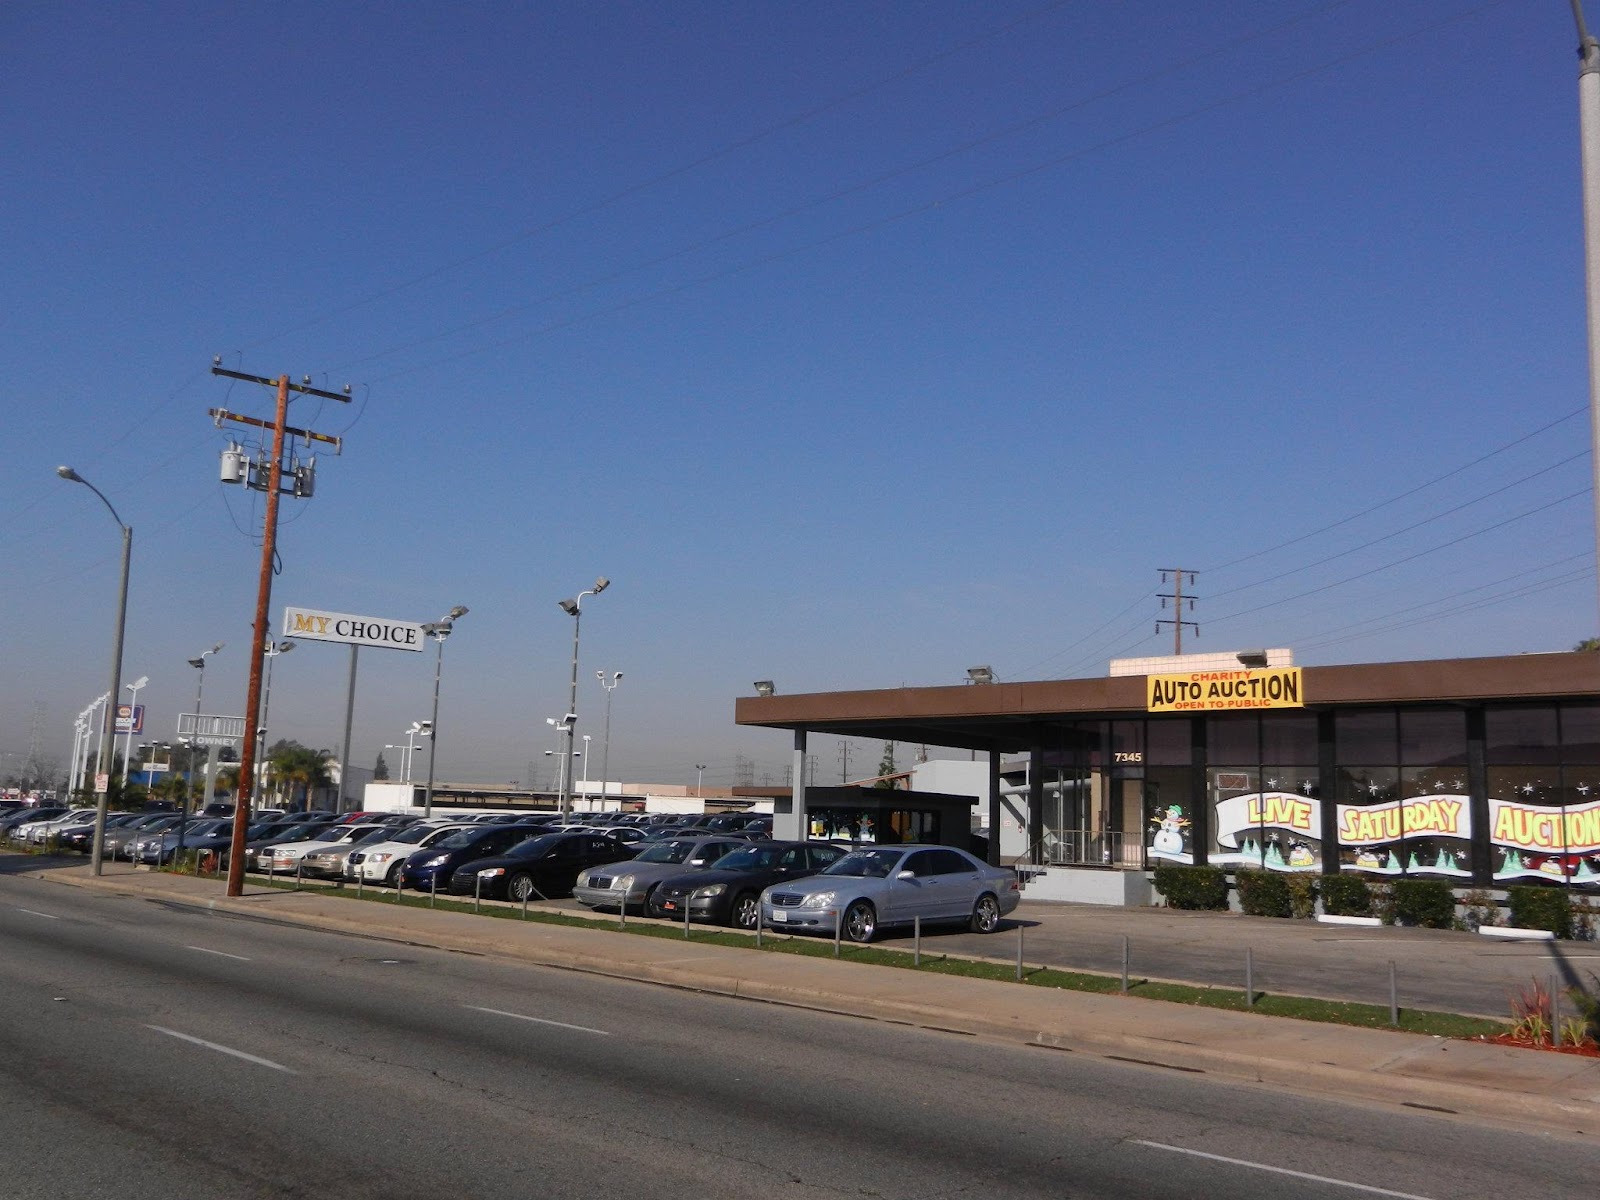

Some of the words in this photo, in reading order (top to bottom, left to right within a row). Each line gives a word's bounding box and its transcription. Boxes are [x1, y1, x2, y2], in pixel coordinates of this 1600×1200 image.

[294, 614, 331, 633] MY
[335, 619, 416, 644] CHOICE
[1191, 671, 1252, 681] CHARITY
[1151, 679, 1202, 707] AUTO
[1208, 671, 1298, 702] AUCTION
[1175, 701, 1204, 709] OPEN
[1228, 699, 1271, 708] PUBLIC
[1115, 752, 1142, 762] 7345
[1248, 796, 1312, 829] LIVE
[1340, 799, 1462, 841] SATURDAY
[1493, 805, 1600, 848] AUCTION
